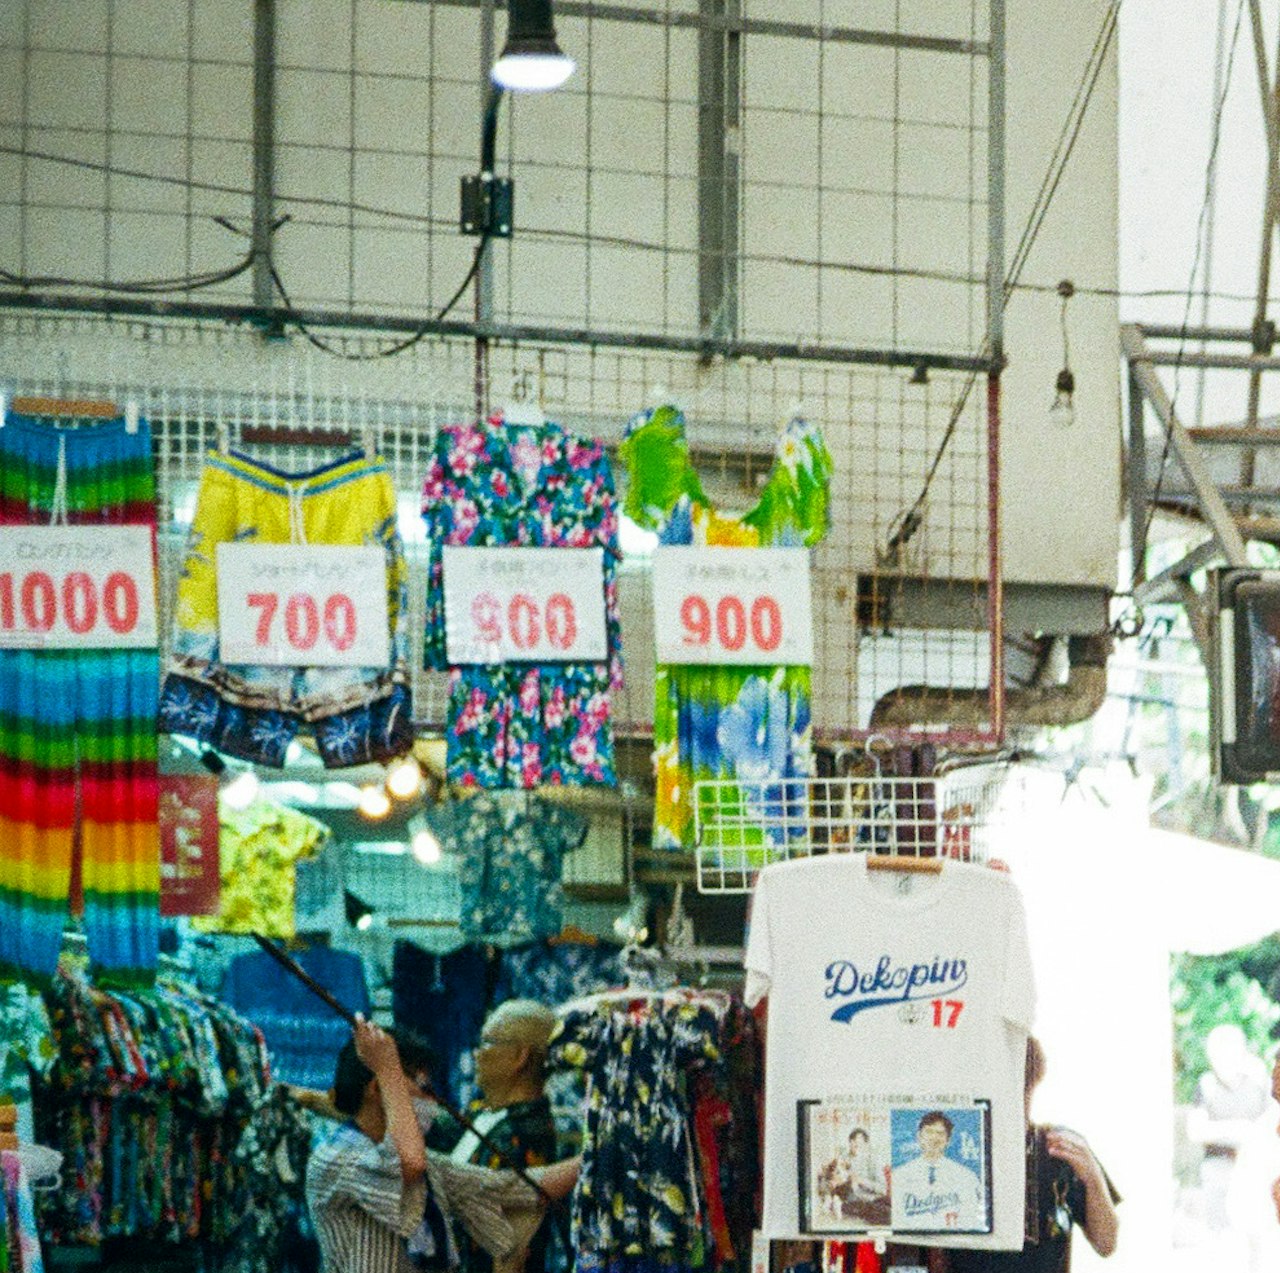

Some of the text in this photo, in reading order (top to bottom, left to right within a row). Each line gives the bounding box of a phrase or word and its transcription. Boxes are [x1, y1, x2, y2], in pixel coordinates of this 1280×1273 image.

[0, 570, 140, 635] 1000
[246, 592, 357, 652] 700
[471, 592, 578, 651] 900
[681, 594, 783, 652] 900
[824, 954, 968, 1001] Dekopin
[929, 998, 965, 1029] 17
